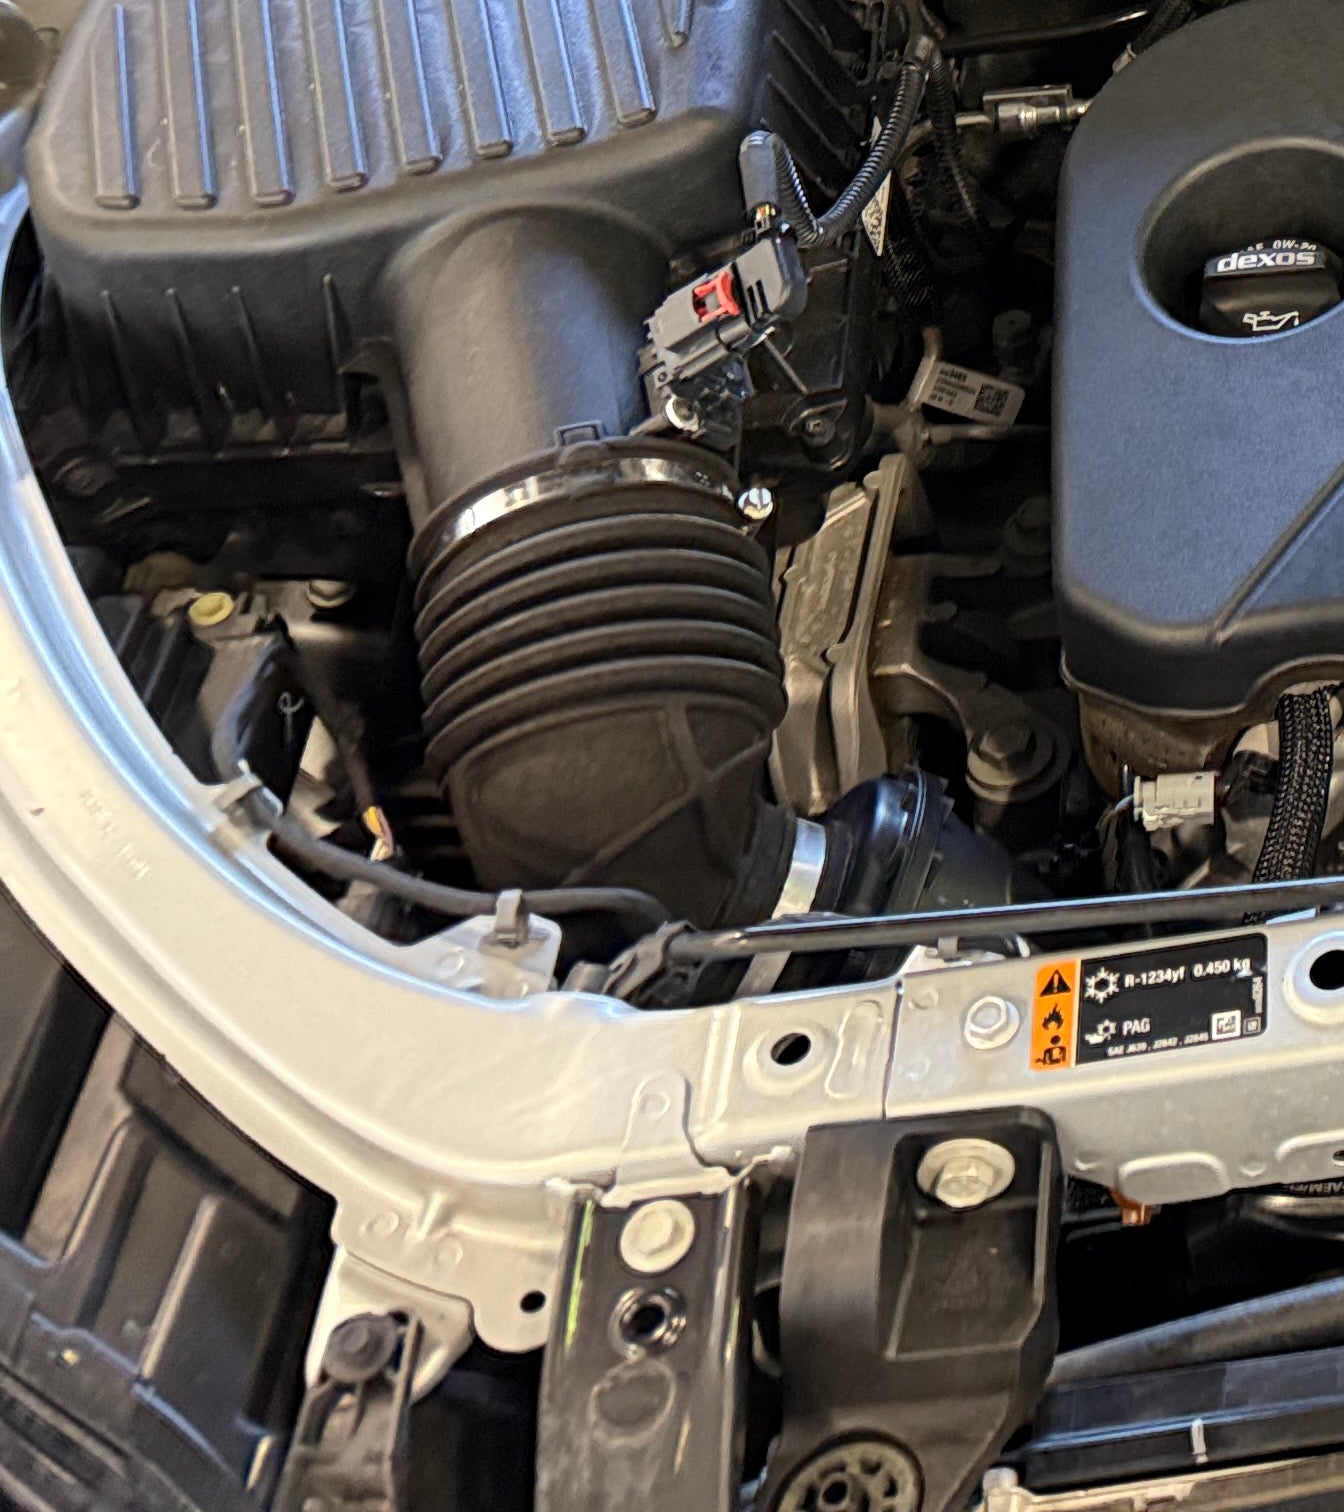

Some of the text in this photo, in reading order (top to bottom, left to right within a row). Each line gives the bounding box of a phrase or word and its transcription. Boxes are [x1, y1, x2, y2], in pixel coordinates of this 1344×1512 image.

[1216, 252, 1316, 273] dexos
[1124, 957, 1251, 988] R-1234yf 0.450 kg
[1122, 1017, 1151, 1037] PAG
